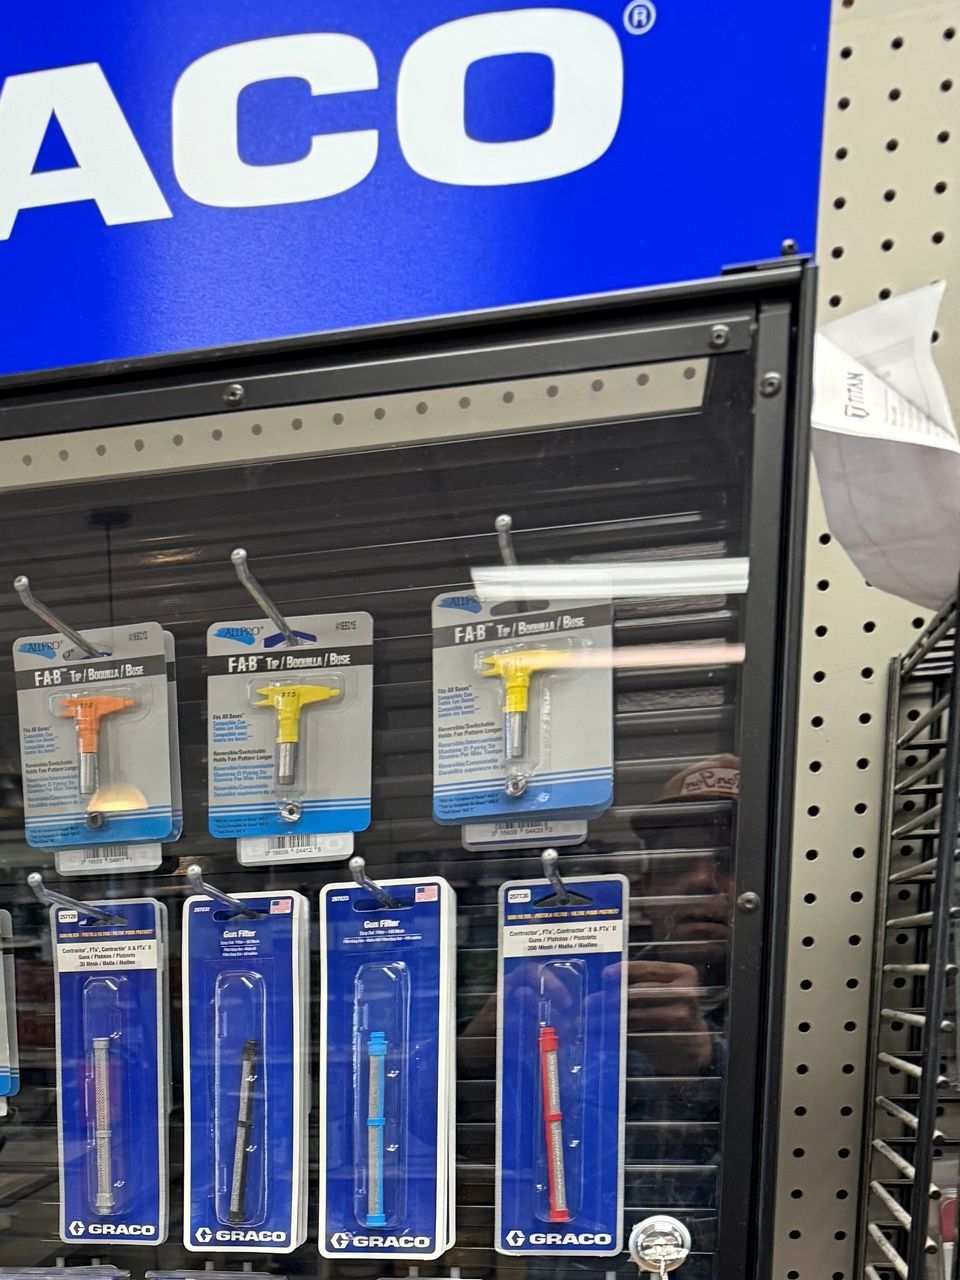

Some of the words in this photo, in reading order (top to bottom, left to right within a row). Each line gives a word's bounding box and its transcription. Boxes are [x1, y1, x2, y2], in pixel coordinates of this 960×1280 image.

[364, 921, 379, 929] Gun
[380, 920, 400, 928] Filter
[89, 1223, 155, 1236] GRACO
[216, 1231, 286, 1242] GRACO
[353, 1236, 430, 1248] GRACO
[530, 1233, 611, 1245] GRACO
